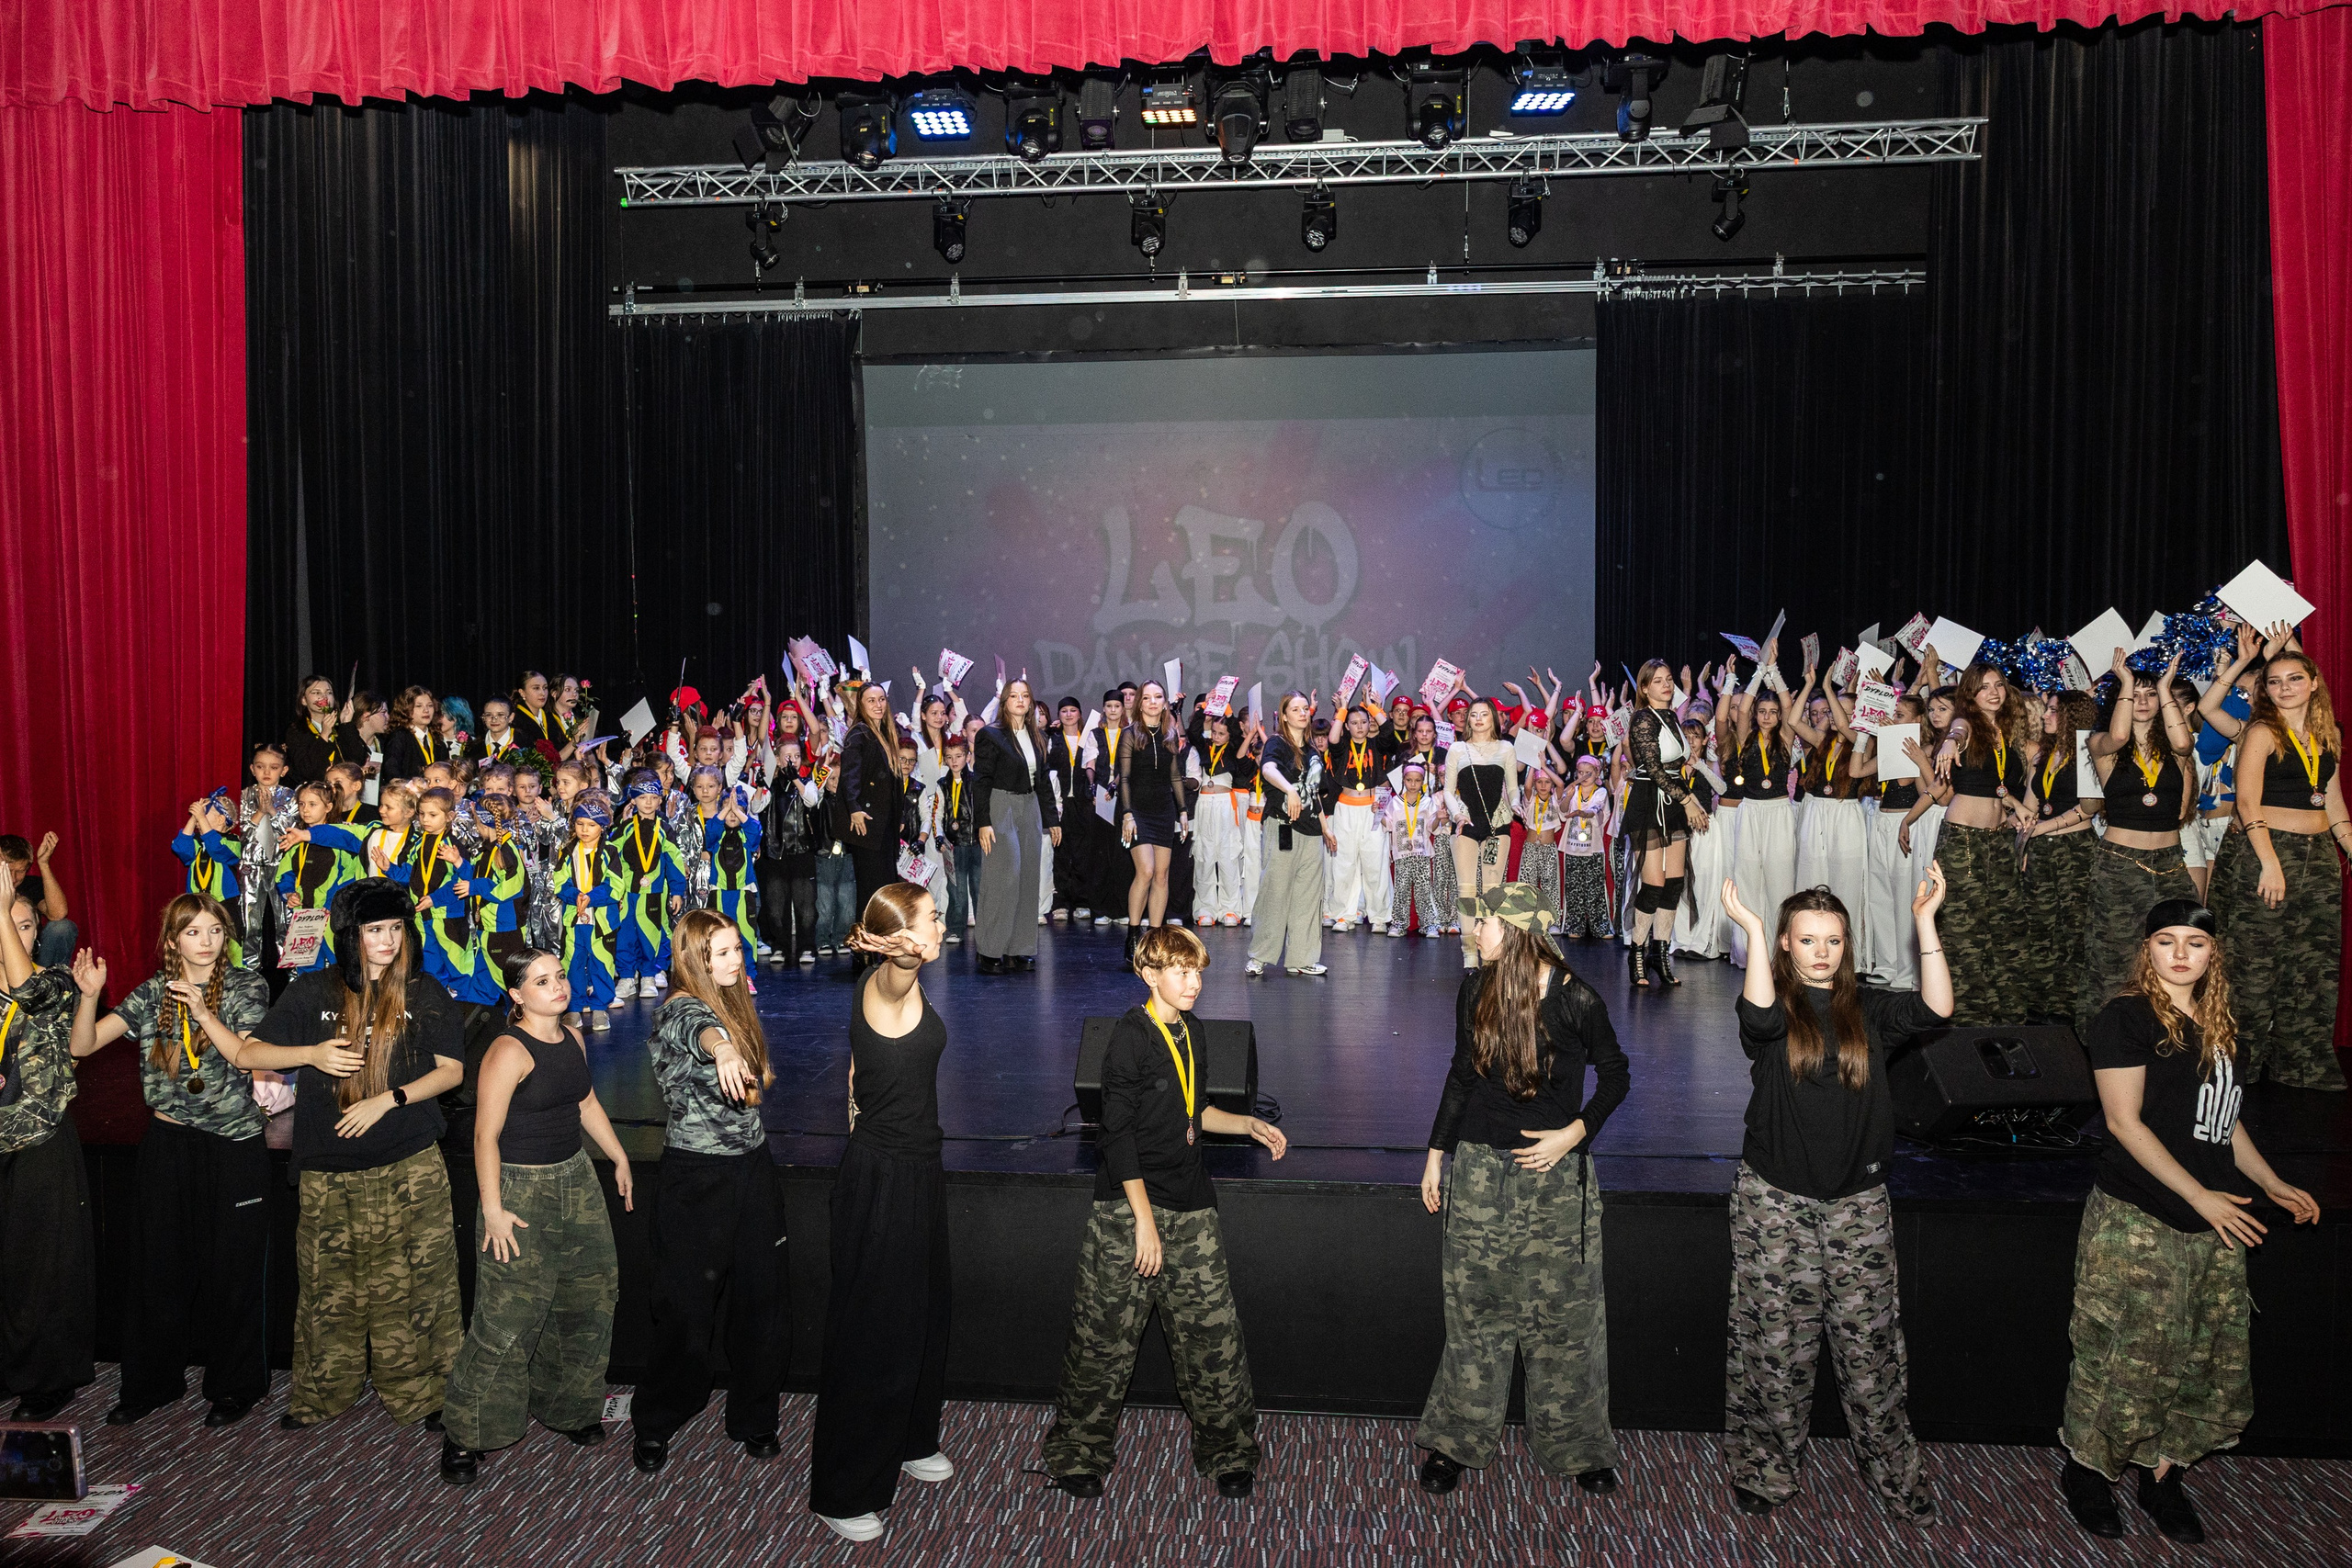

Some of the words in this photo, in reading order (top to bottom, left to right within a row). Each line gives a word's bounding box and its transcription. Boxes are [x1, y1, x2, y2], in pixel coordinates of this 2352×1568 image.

[1093, 500, 1358, 634] LEO
[1864, 685, 1895, 700] DYPLOM
[1860, 705, 1886, 721] LEO
[296, 914, 326, 922] DYPLOM
[290, 935, 315, 952] LEO
[604, 1396, 621, 1419] DYPLOM
[40, 1507, 96, 1524] LEO
